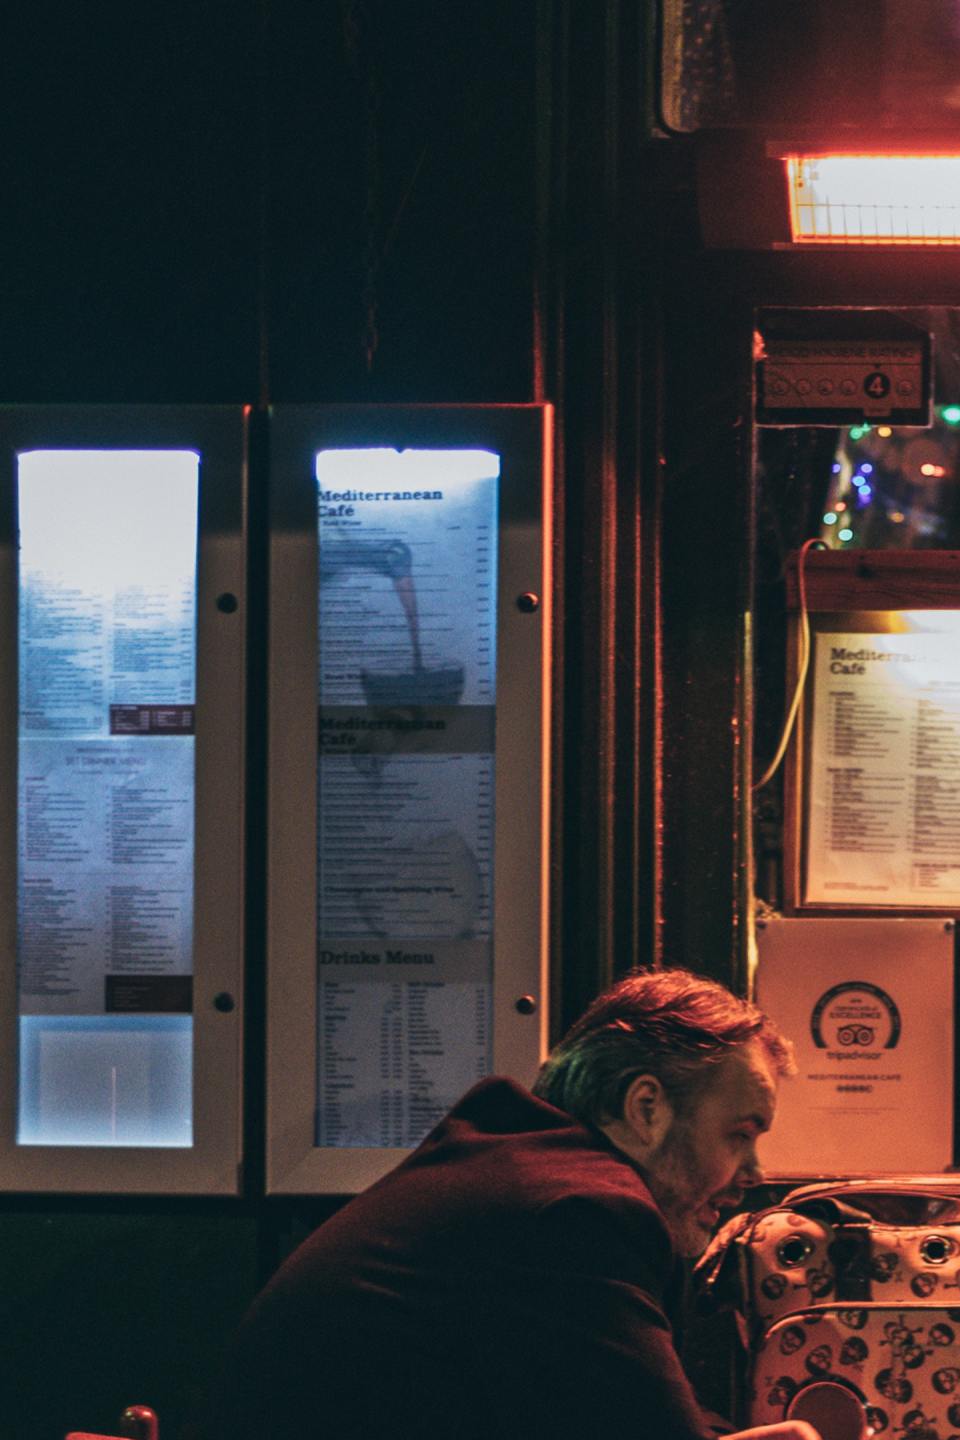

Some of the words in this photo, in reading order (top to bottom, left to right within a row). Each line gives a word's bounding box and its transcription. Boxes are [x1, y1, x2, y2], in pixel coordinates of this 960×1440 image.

[869, 375, 884, 395] 4
[318, 489, 443, 502] Mediterranean
[318, 504, 355, 517] Café
[830, 662, 866, 675] Café
[319, 717, 446, 730] Mediterranean
[319, 731, 356, 745] Café
[319, 950, 381, 965] Drinks
[385, 951, 435, 965] Menu
[826, 1051, 883, 1061] tripadvisor
